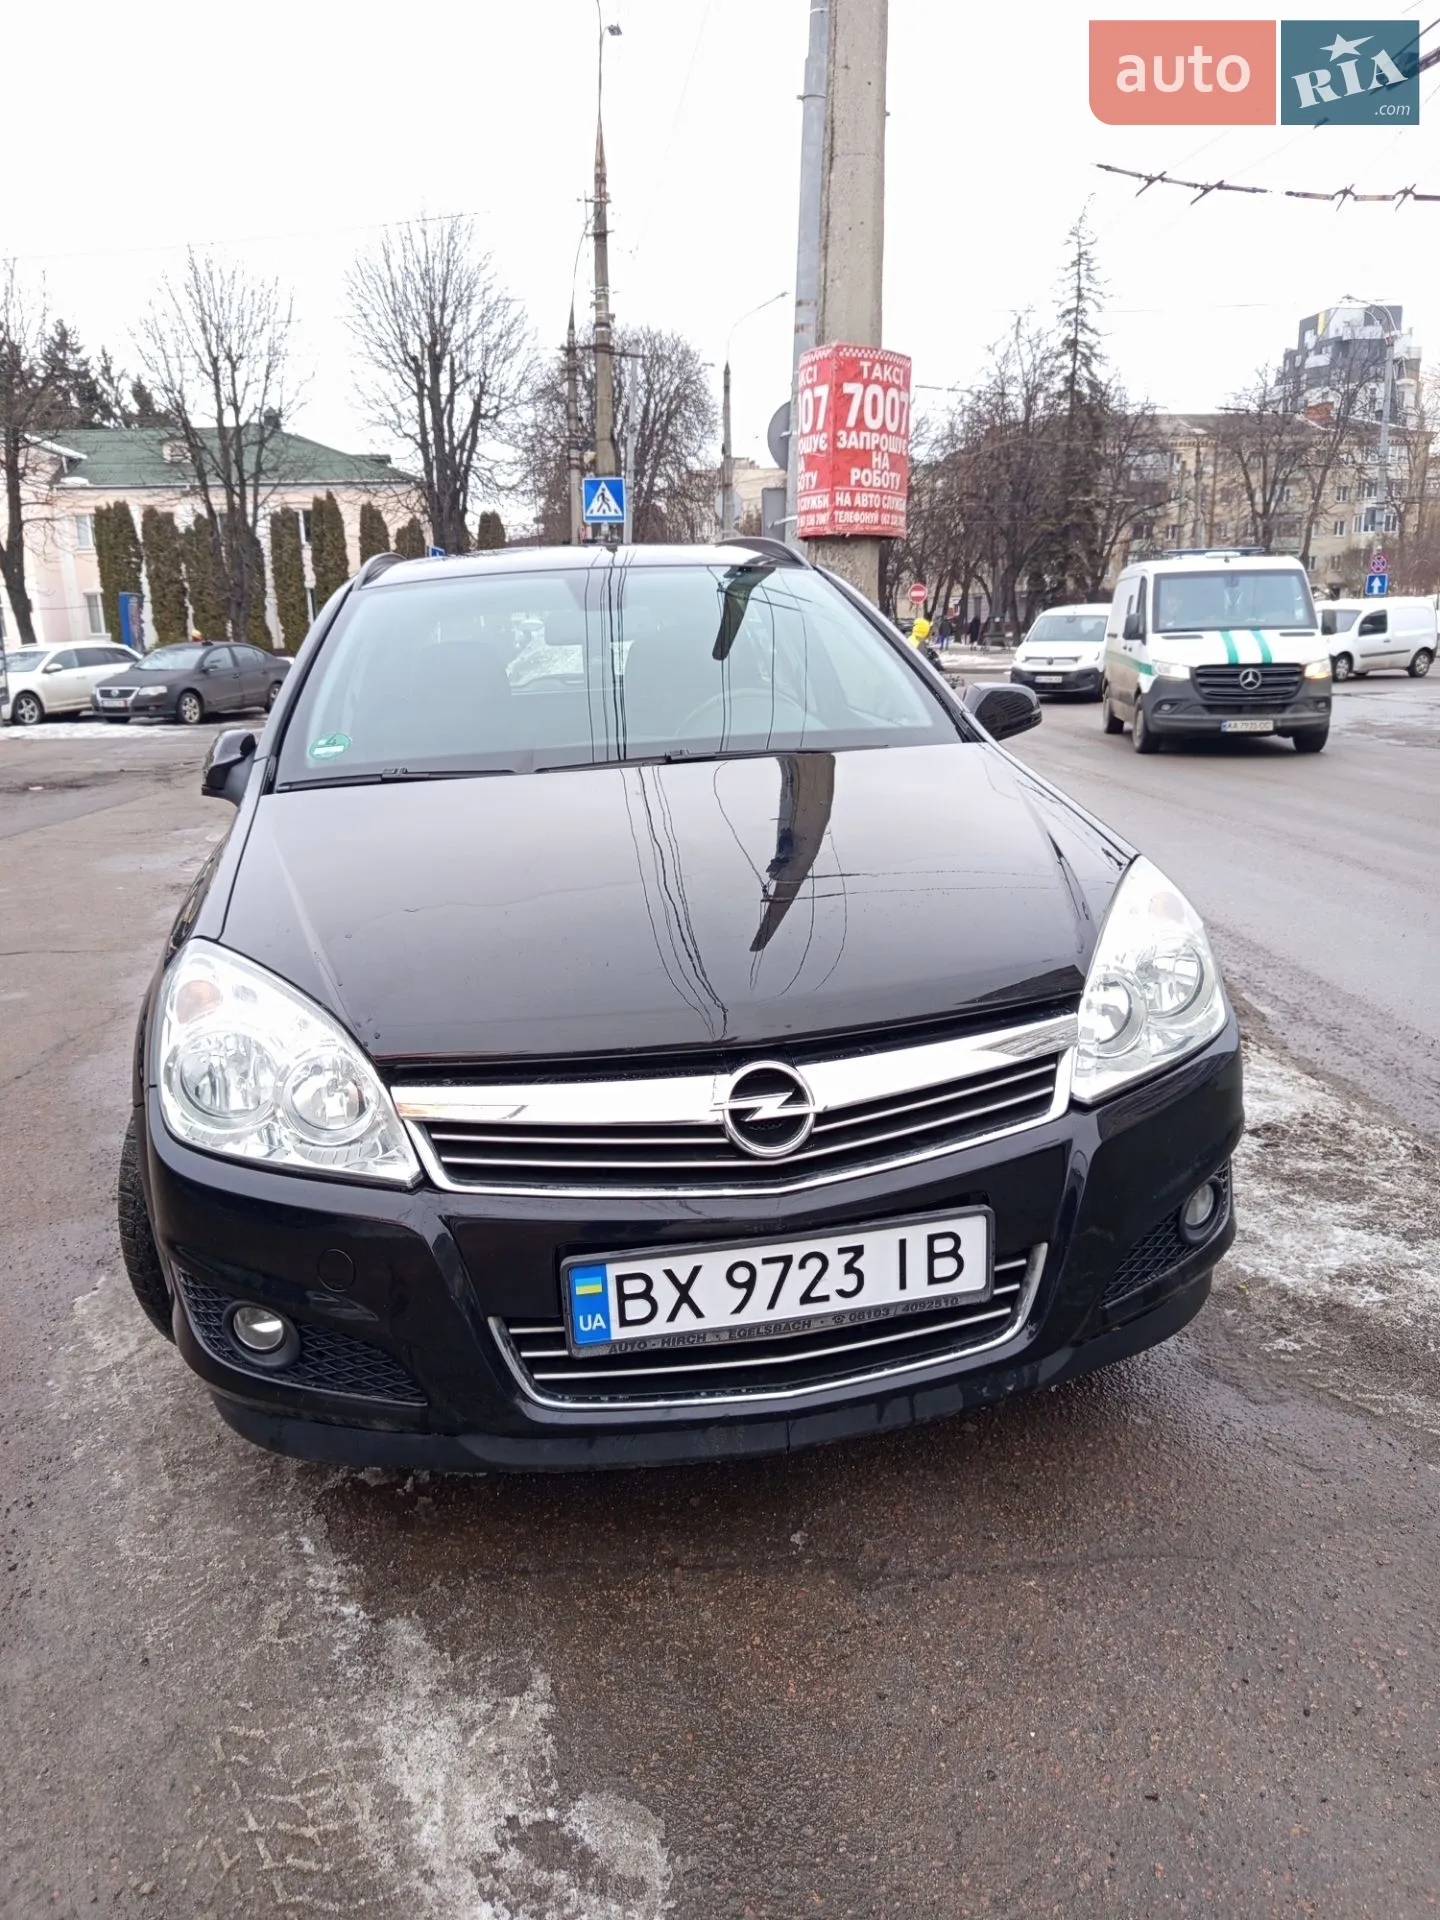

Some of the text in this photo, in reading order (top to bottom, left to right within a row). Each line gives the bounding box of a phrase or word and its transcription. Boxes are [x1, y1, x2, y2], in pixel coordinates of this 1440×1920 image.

[860, 361, 904, 384] ТАКСІ
[798, 384, 829, 435] 07
[842, 382, 909, 435] 7007
[871, 450, 890, 469] НА
[851, 468, 900, 489] РОБОТУ
[835, 492, 852, 507] НА
[854, 492, 880, 508] АВТО
[615, 1231, 964, 1328] BX 9723 IB
[579, 1314, 606, 1331] UA
[609, 1340, 648, 1354] AUTO
[661, 1333, 707, 1348] HIRCH
[728, 1319, 812, 1339] EGELSBACH
[849, 1307, 890, 1322] 06103
